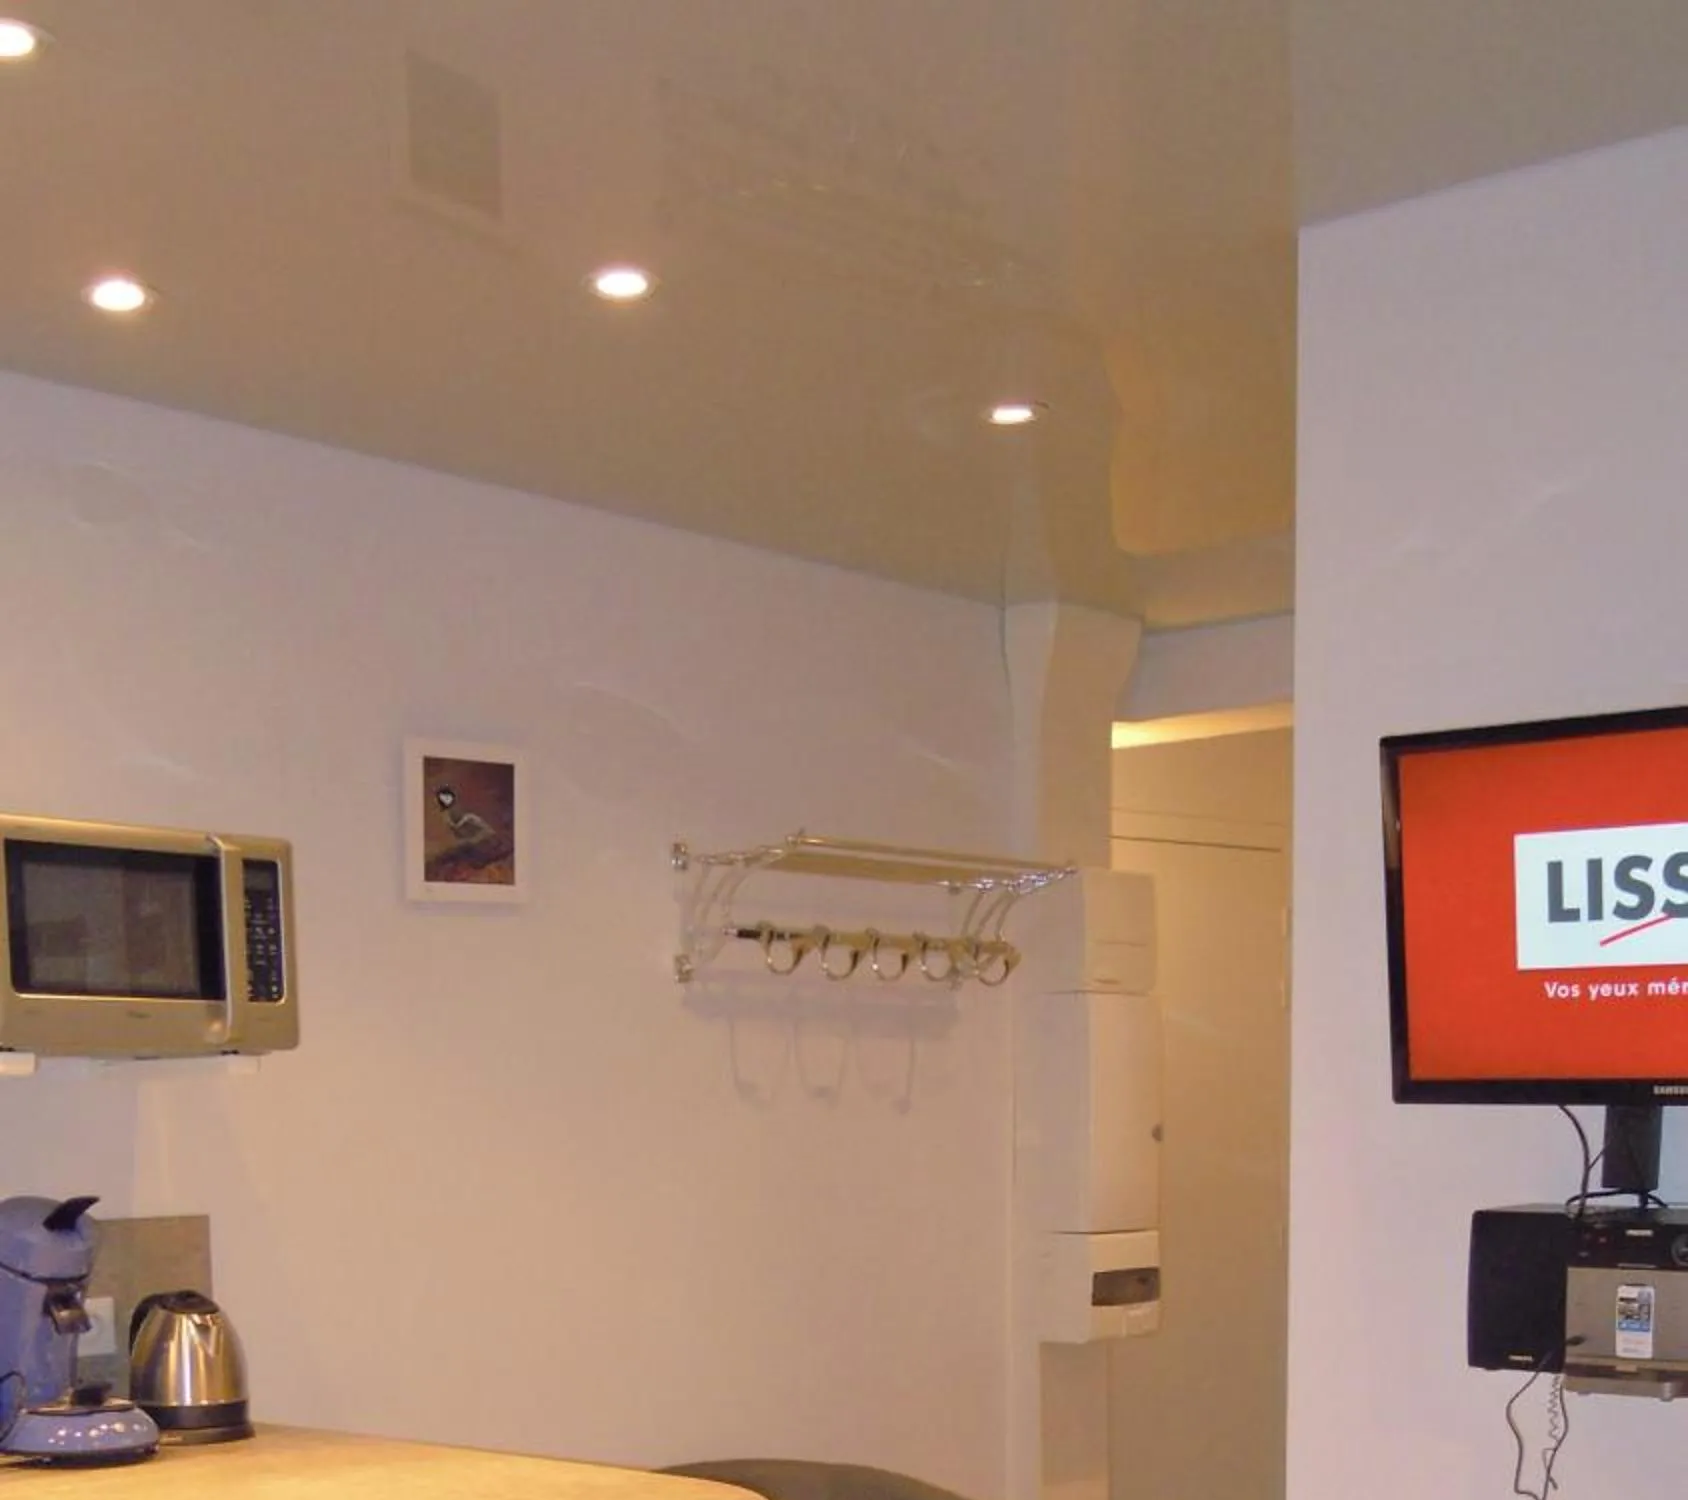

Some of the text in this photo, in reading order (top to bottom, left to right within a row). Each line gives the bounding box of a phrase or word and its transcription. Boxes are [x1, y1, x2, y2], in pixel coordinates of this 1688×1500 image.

[1547, 851, 1688, 922] LISS
[1543, 981, 1580, 999] Vos
[1588, 982, 1638, 1001] yeux
